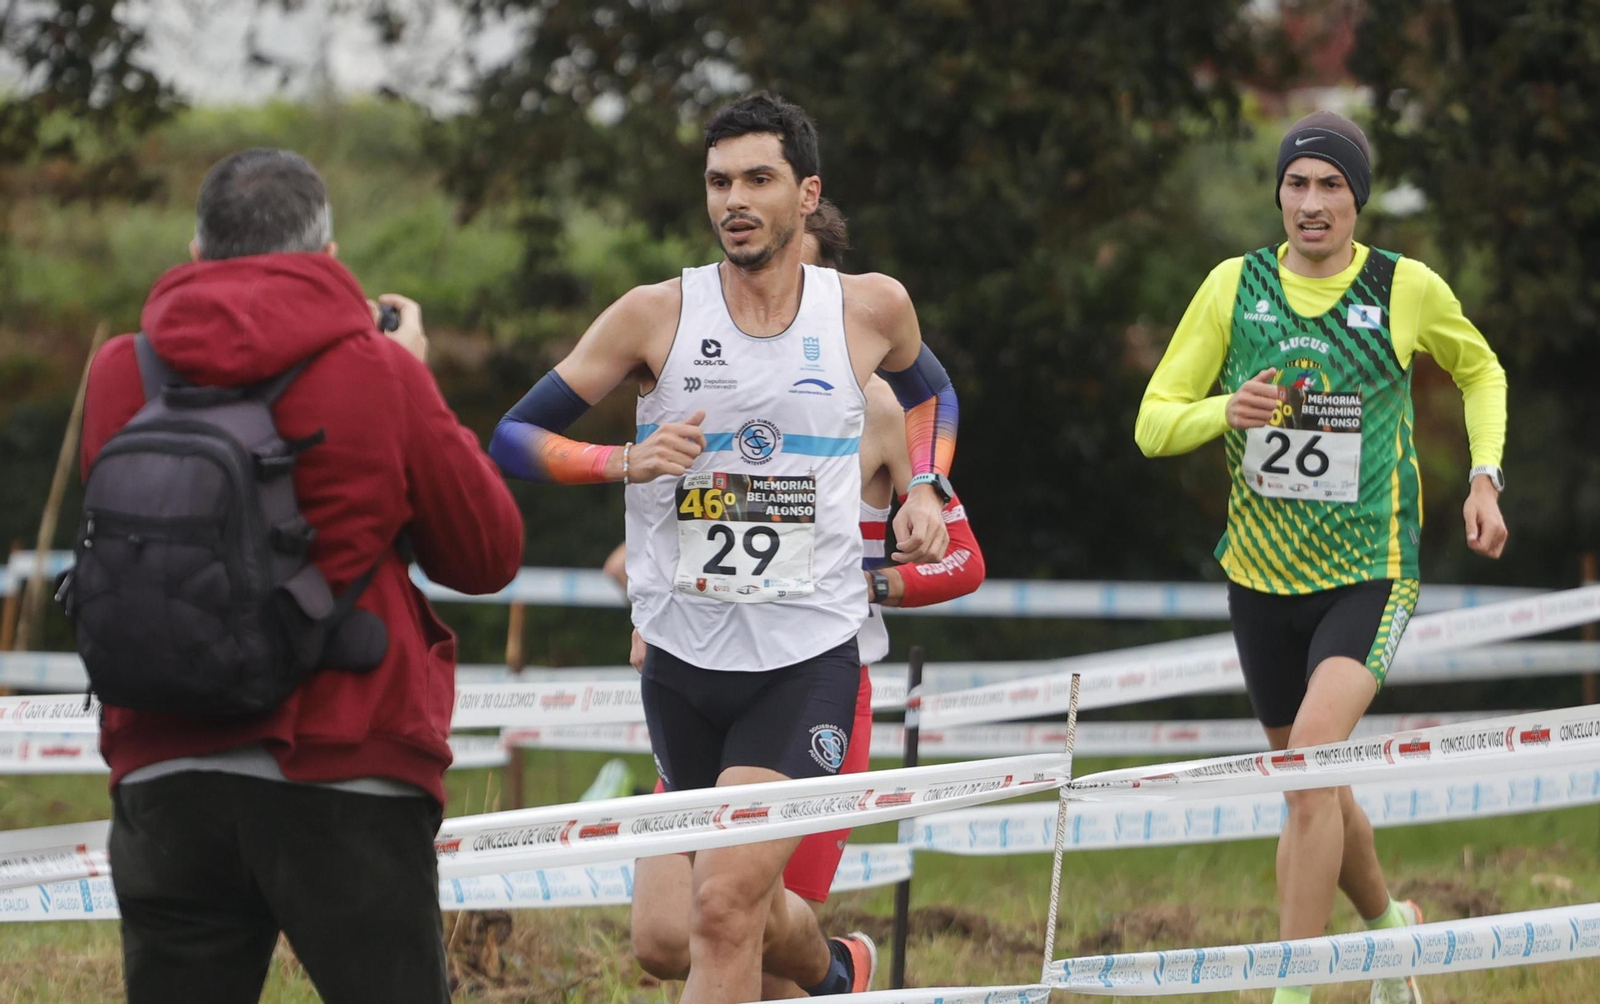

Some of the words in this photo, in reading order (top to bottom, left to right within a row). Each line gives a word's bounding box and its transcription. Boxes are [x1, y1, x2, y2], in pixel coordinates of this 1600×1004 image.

[1243, 313, 1277, 323] VIATOR
[1278, 336, 1329, 354] LUCUS
[1308, 394, 1361, 405] MEMORIAL
[1269, 399, 1292, 426] 6º
[1302, 405, 1361, 416] BELARMINO
[1318, 417, 1360, 428] ALONSO
[1260, 430, 1329, 477] 26
[753, 480, 816, 490] MEMORIAL
[746, 492, 816, 503] BELARMINO
[765, 505, 814, 516] ALONSO
[703, 524, 780, 575] 29
[1560, 721, 1594, 741] CONCELLO
[1440, 733, 1475, 754] CONCELLO
[1476, 732, 1487, 749] DE
[1487, 730, 1504, 747] VIGO
[1314, 746, 1352, 766] CONCELLO
[1353, 745, 1364, 762] DE
[1364, 743, 1382, 759] VIGO
[780, 799, 826, 819] CONCELLO
[824, 797, 839, 813] DE
[837, 795, 860, 811] VIGO
[631, 813, 679, 835] CONCELLO
[677, 812, 692, 829] DE
[691, 810, 714, 827] VIGO
[473, 828, 523, 851] CONCELLO
[522, 828, 540, 846] DE
[537, 825, 561, 844] VIGO
